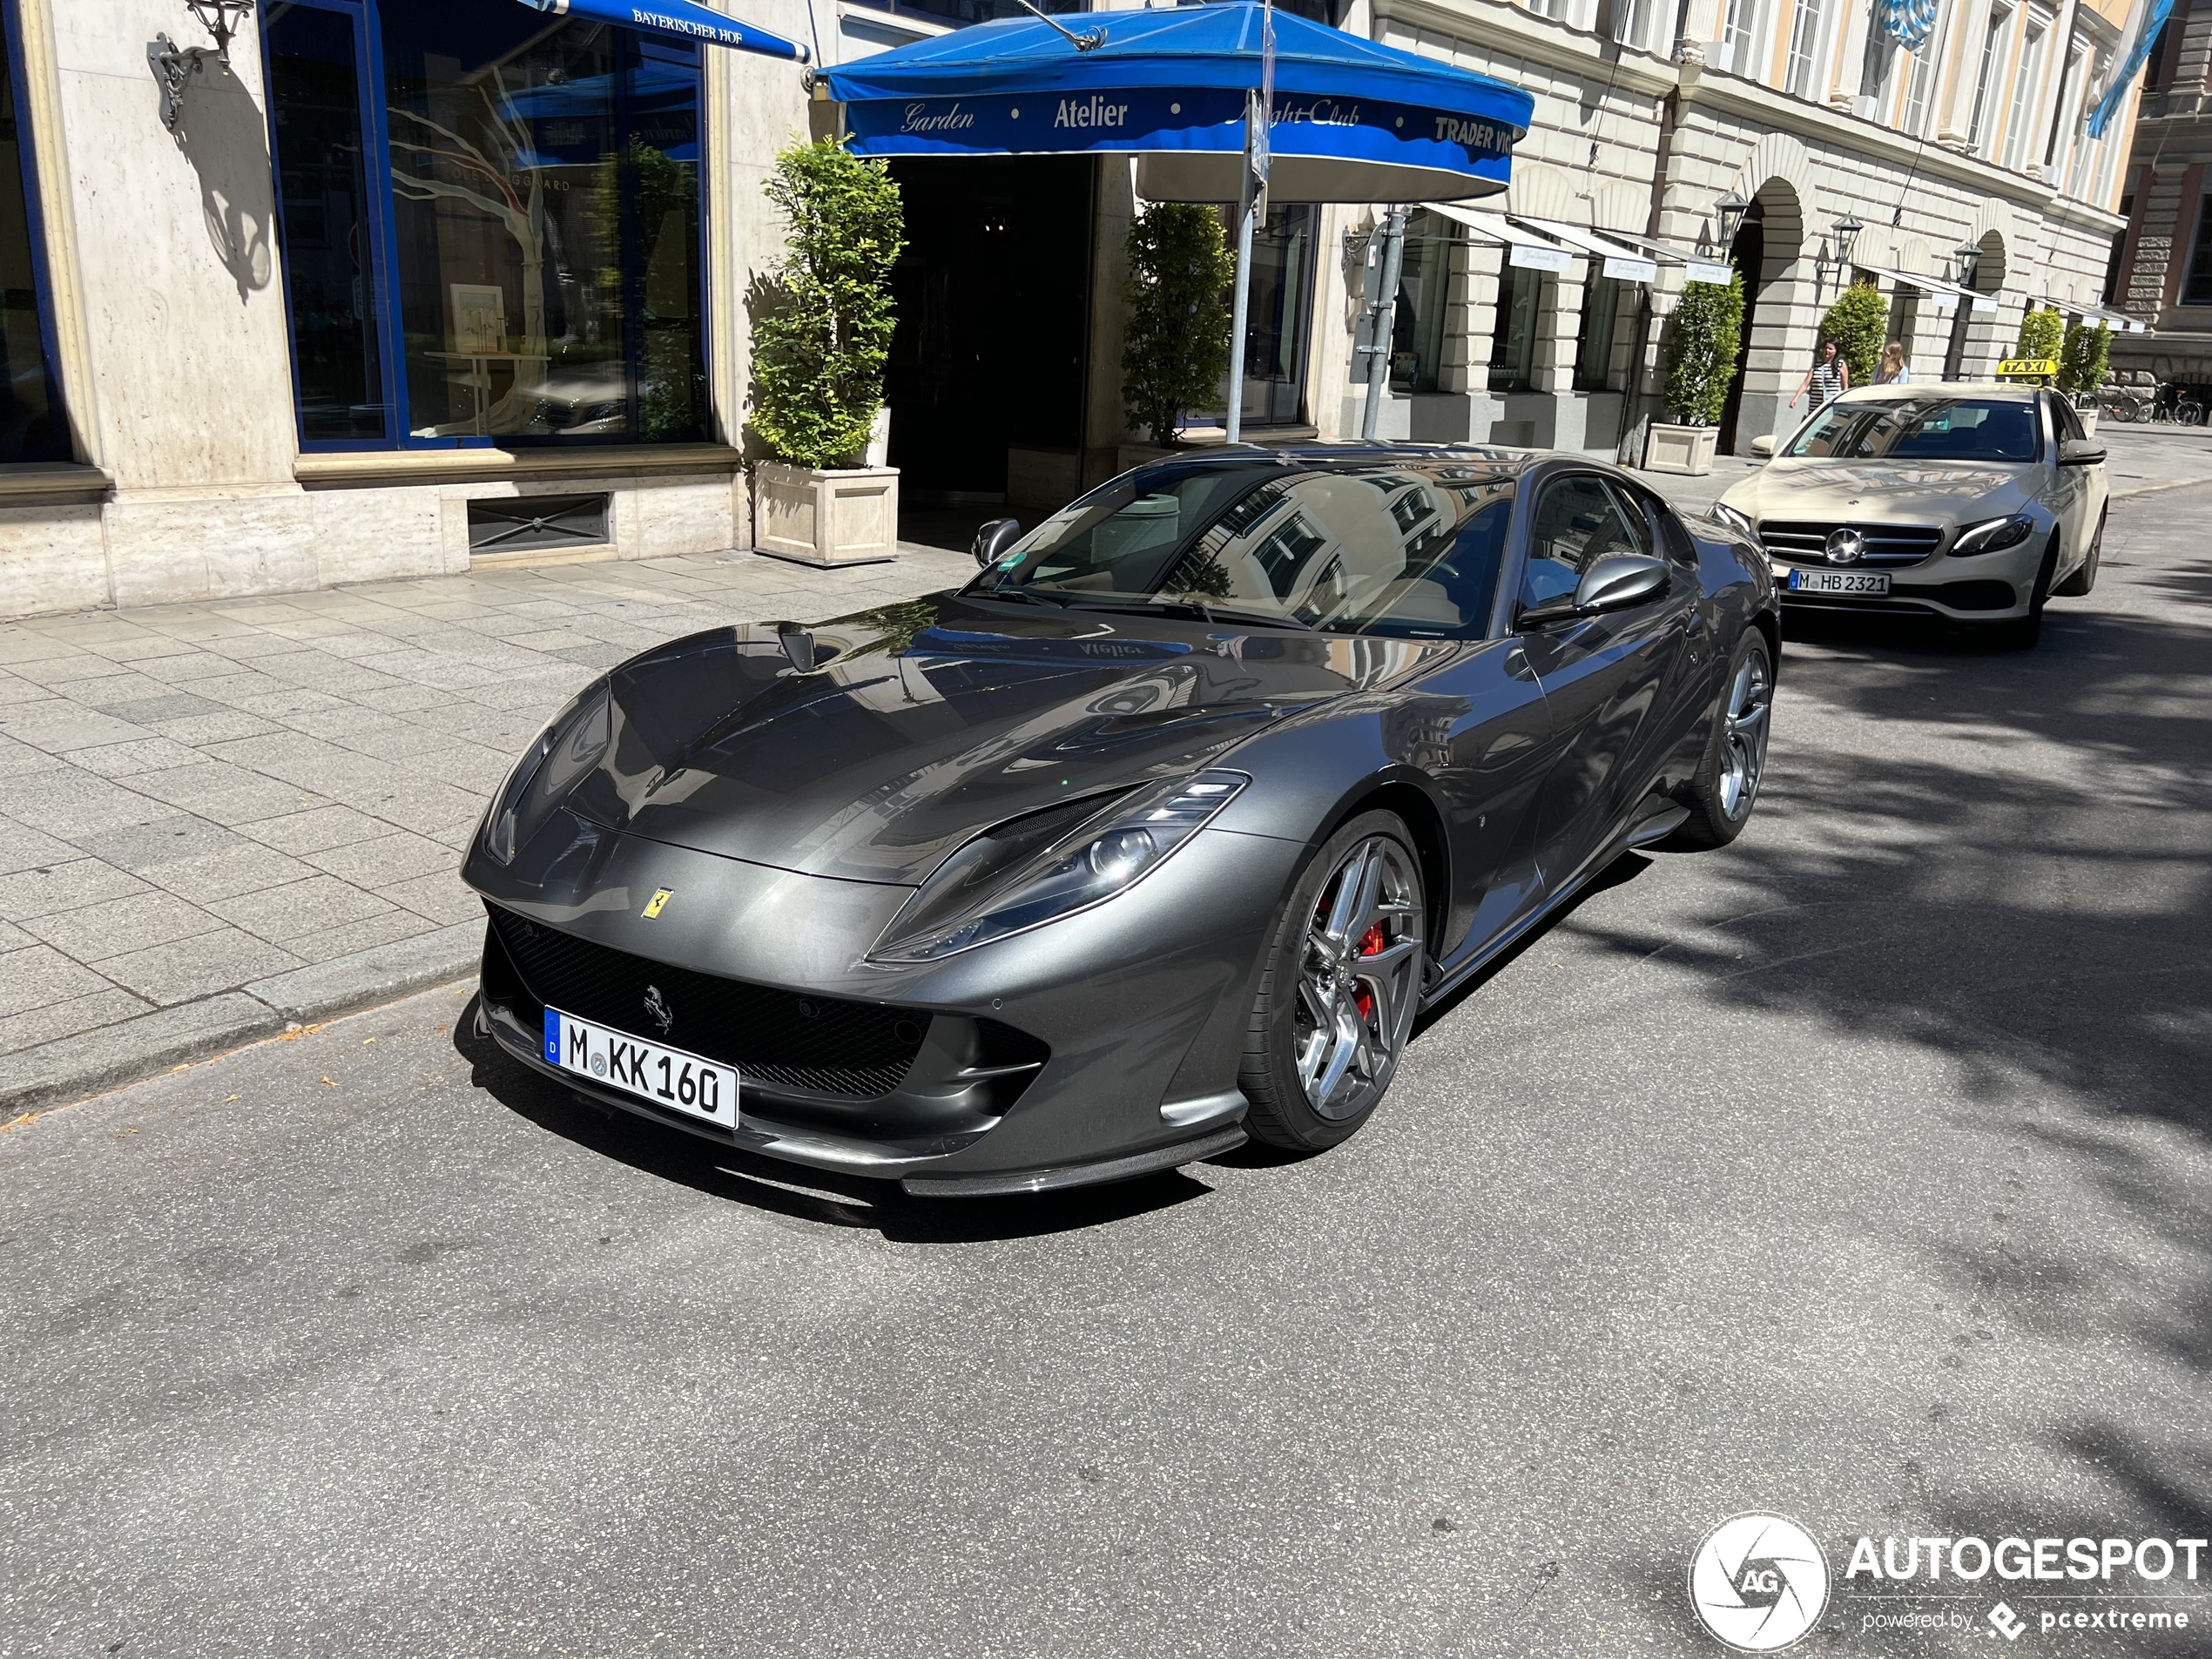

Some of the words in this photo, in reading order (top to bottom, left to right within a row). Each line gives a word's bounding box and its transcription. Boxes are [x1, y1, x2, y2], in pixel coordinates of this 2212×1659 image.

[632, 9, 717, 40] BAYERISCHER
[718, 29, 743, 44] HOF
[900, 103, 974, 132] Garden
[1054, 95, 1129, 128] Atelier
[1435, 117, 1494, 150] TRADER
[452, 168, 480, 181] OLE
[2006, 361, 2047, 373] TAXI
[1798, 573, 1810, 589] M
[1821, 575, 1842, 590] HB
[1844, 576, 1886, 592] 2321
[550, 1042, 556, 1054] D
[570, 1023, 588, 1069] M
[610, 1037, 650, 1092] KK
[657, 1055, 718, 1114] 160
